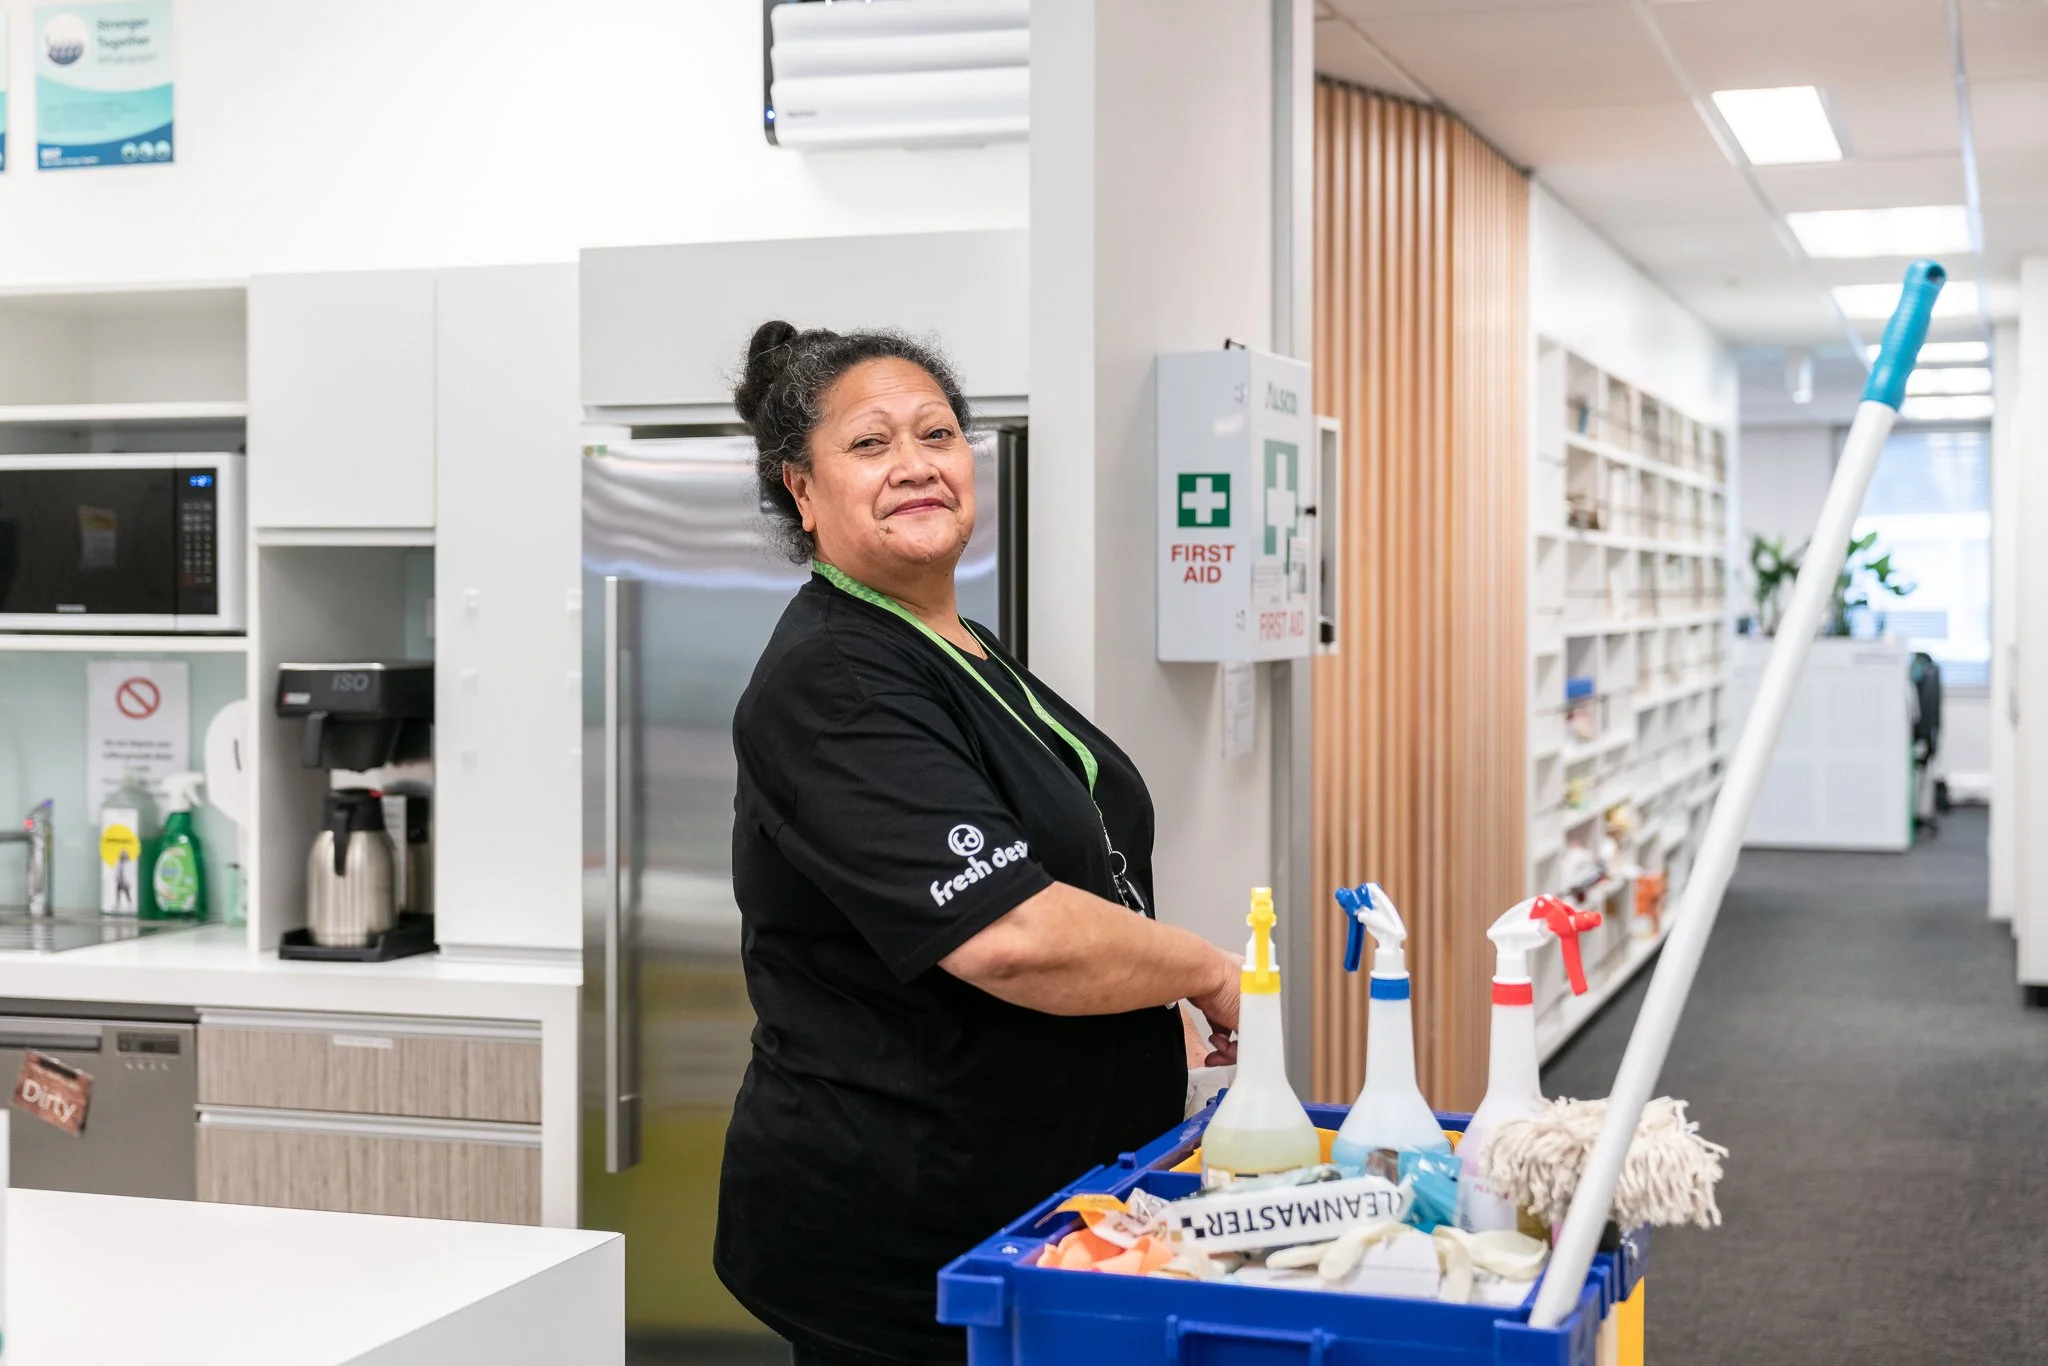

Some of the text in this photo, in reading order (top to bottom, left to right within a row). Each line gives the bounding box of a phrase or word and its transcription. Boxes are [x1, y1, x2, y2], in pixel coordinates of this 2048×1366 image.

[1170, 544, 1235, 563] FIRST
[1183, 565, 1222, 584] AID
[1259, 612, 1287, 642] FIRST
[331, 672, 370, 692] ISO
[930, 856, 993, 907] fresh
[21, 1078, 77, 1123] Dirty
